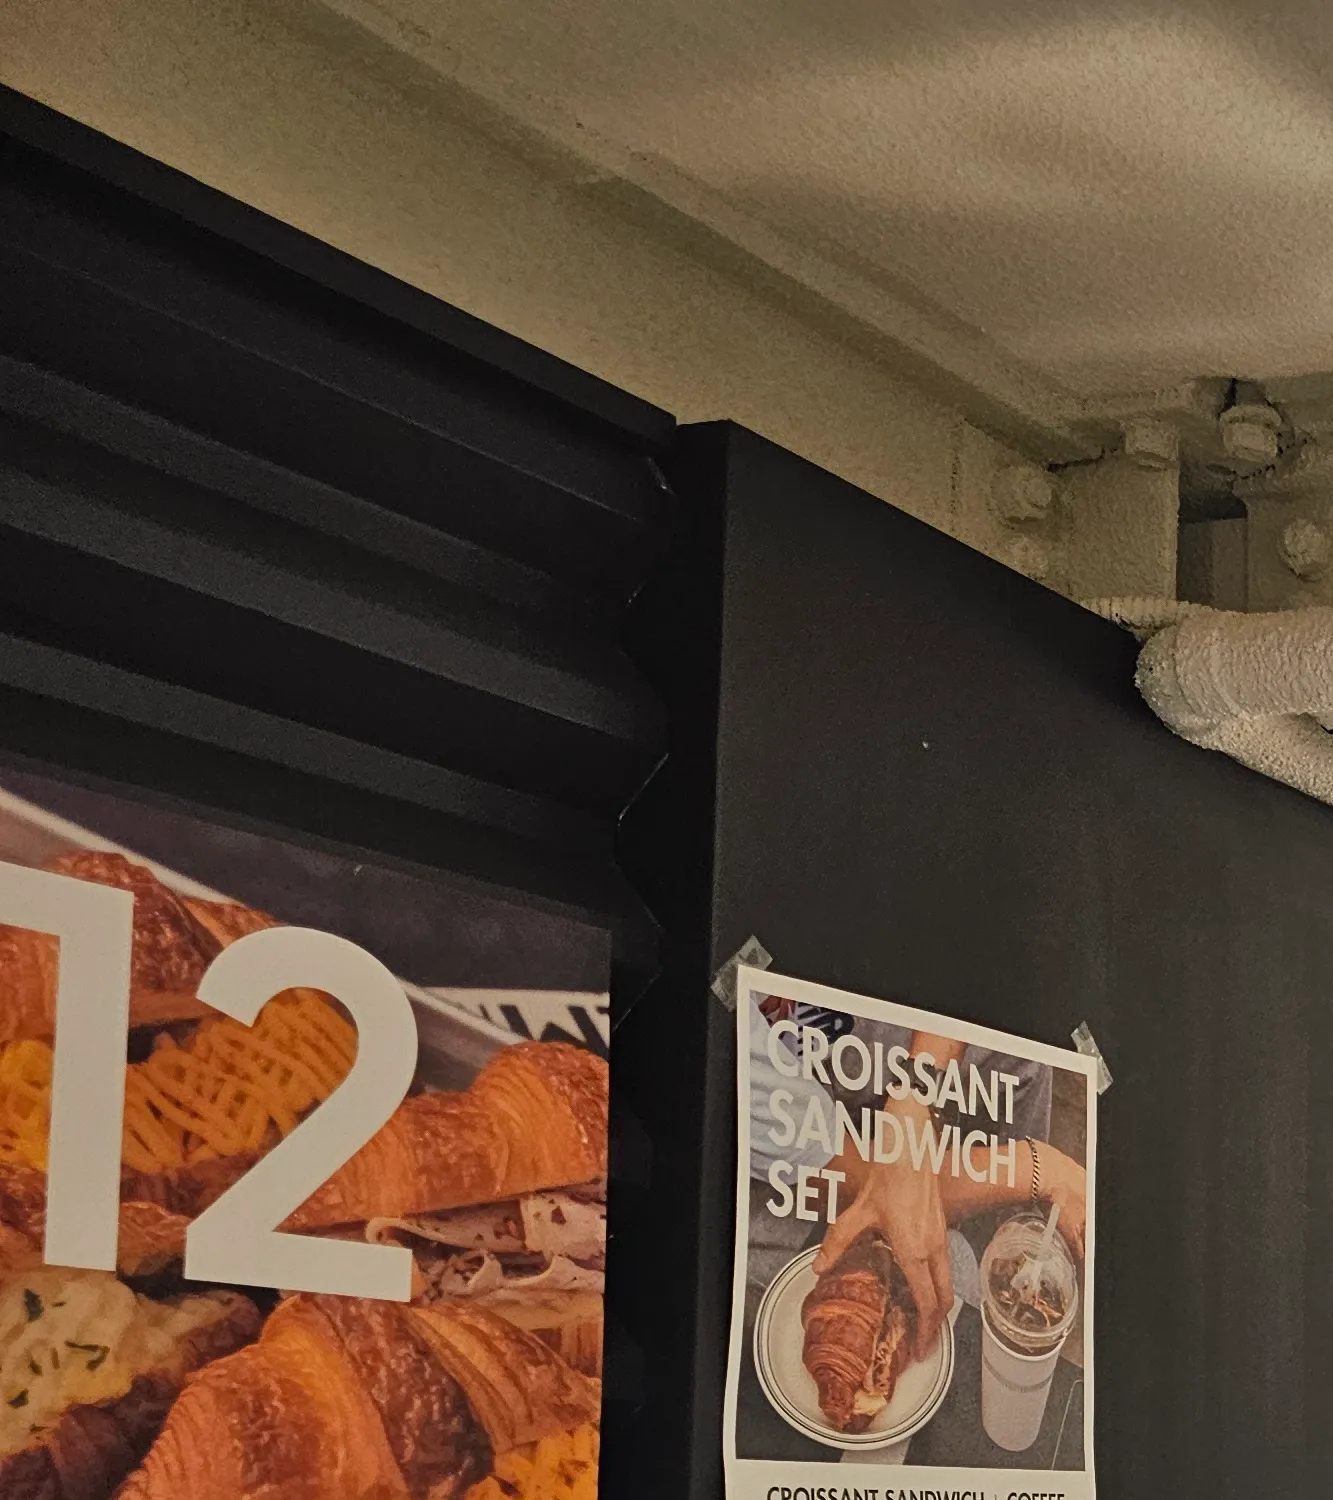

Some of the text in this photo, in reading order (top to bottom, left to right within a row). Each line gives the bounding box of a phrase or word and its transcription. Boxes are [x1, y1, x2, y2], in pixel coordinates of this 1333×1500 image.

[0, 860, 420, 1303] 12
[766, 1018, 1021, 1126] CROISSANT
[767, 1088, 1017, 1190] SANDWICH
[765, 1159, 847, 1226] SET
